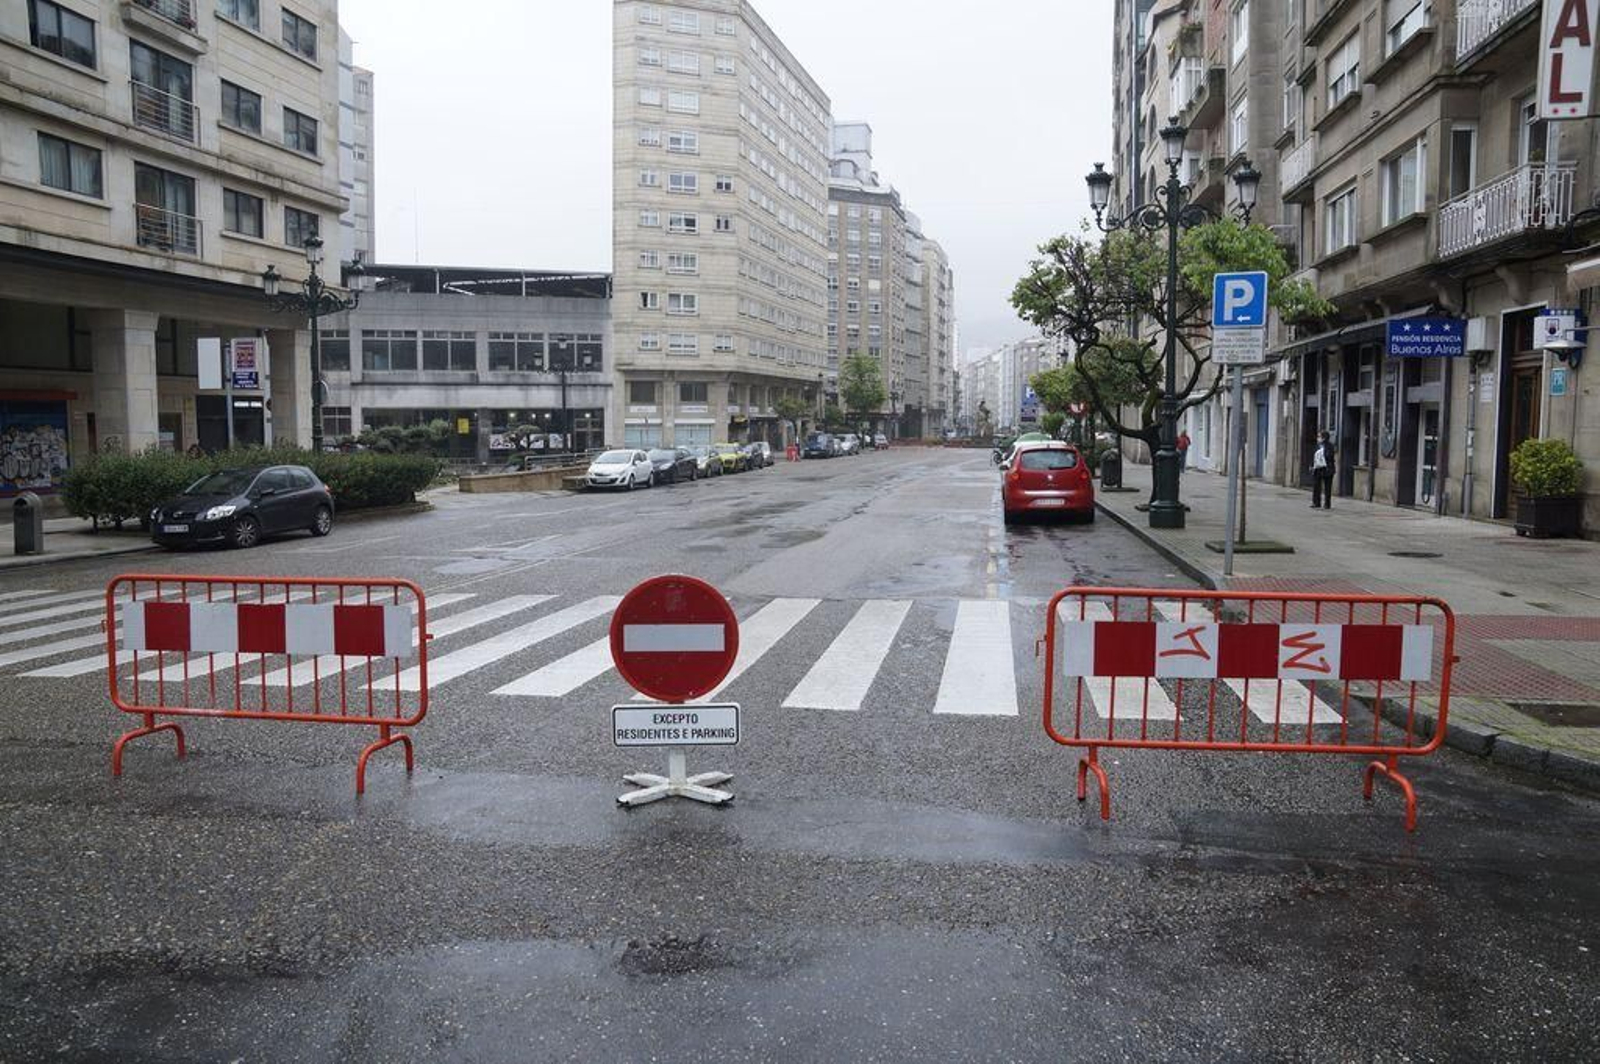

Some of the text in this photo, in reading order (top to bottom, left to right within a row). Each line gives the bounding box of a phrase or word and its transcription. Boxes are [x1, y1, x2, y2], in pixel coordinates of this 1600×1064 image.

[1223, 279, 1255, 321] P
[1391, 334, 1462, 343] PENSIÓN RESIDENCIA
[1391, 344, 1462, 354] Buenos Aires
[652, 713, 699, 725] EXCEPTO
[616, 727, 735, 740] RESIDENTES E PARKING
